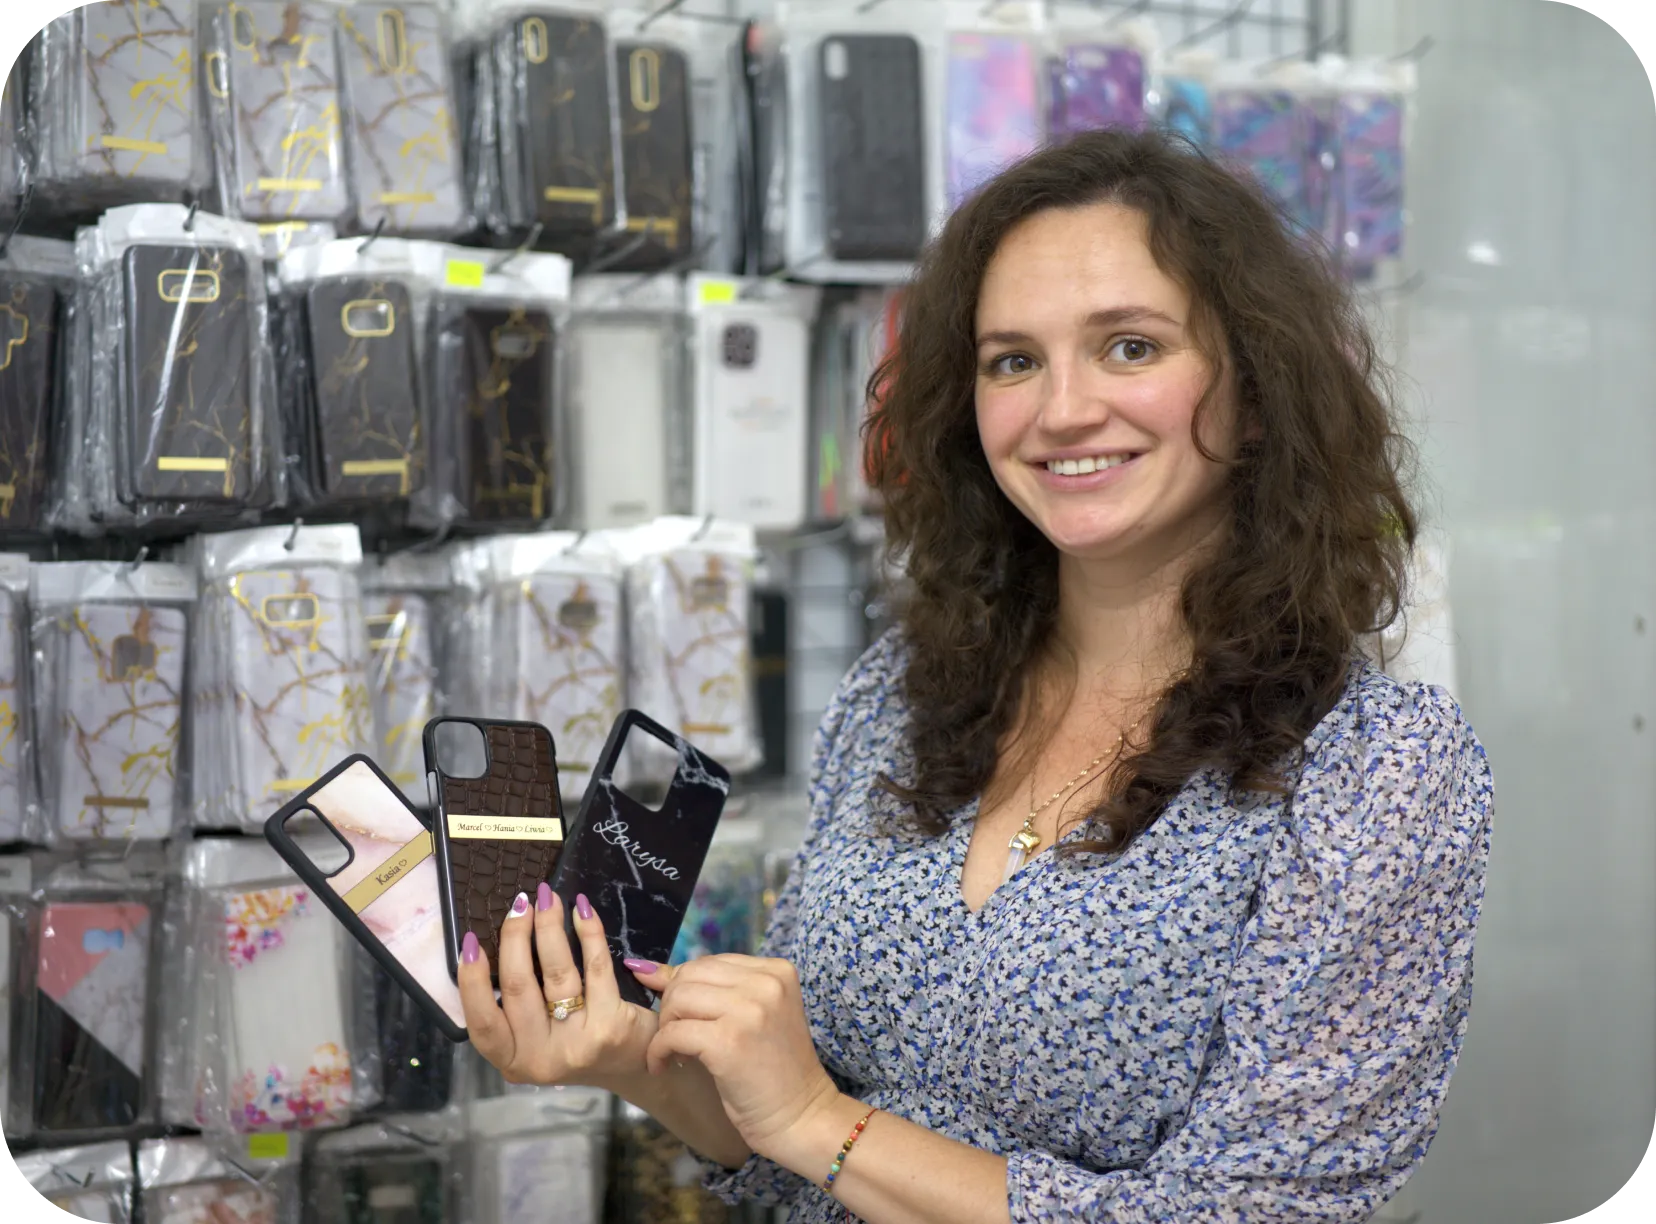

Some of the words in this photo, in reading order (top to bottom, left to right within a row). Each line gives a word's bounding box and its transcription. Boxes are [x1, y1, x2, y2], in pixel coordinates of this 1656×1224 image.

[457, 822, 482, 831] Marcel
[492, 824, 515, 833] Hania
[524, 825, 546, 834] Liwia
[592, 819, 681, 880] Larysa
[375, 865, 402, 886] Kasia
